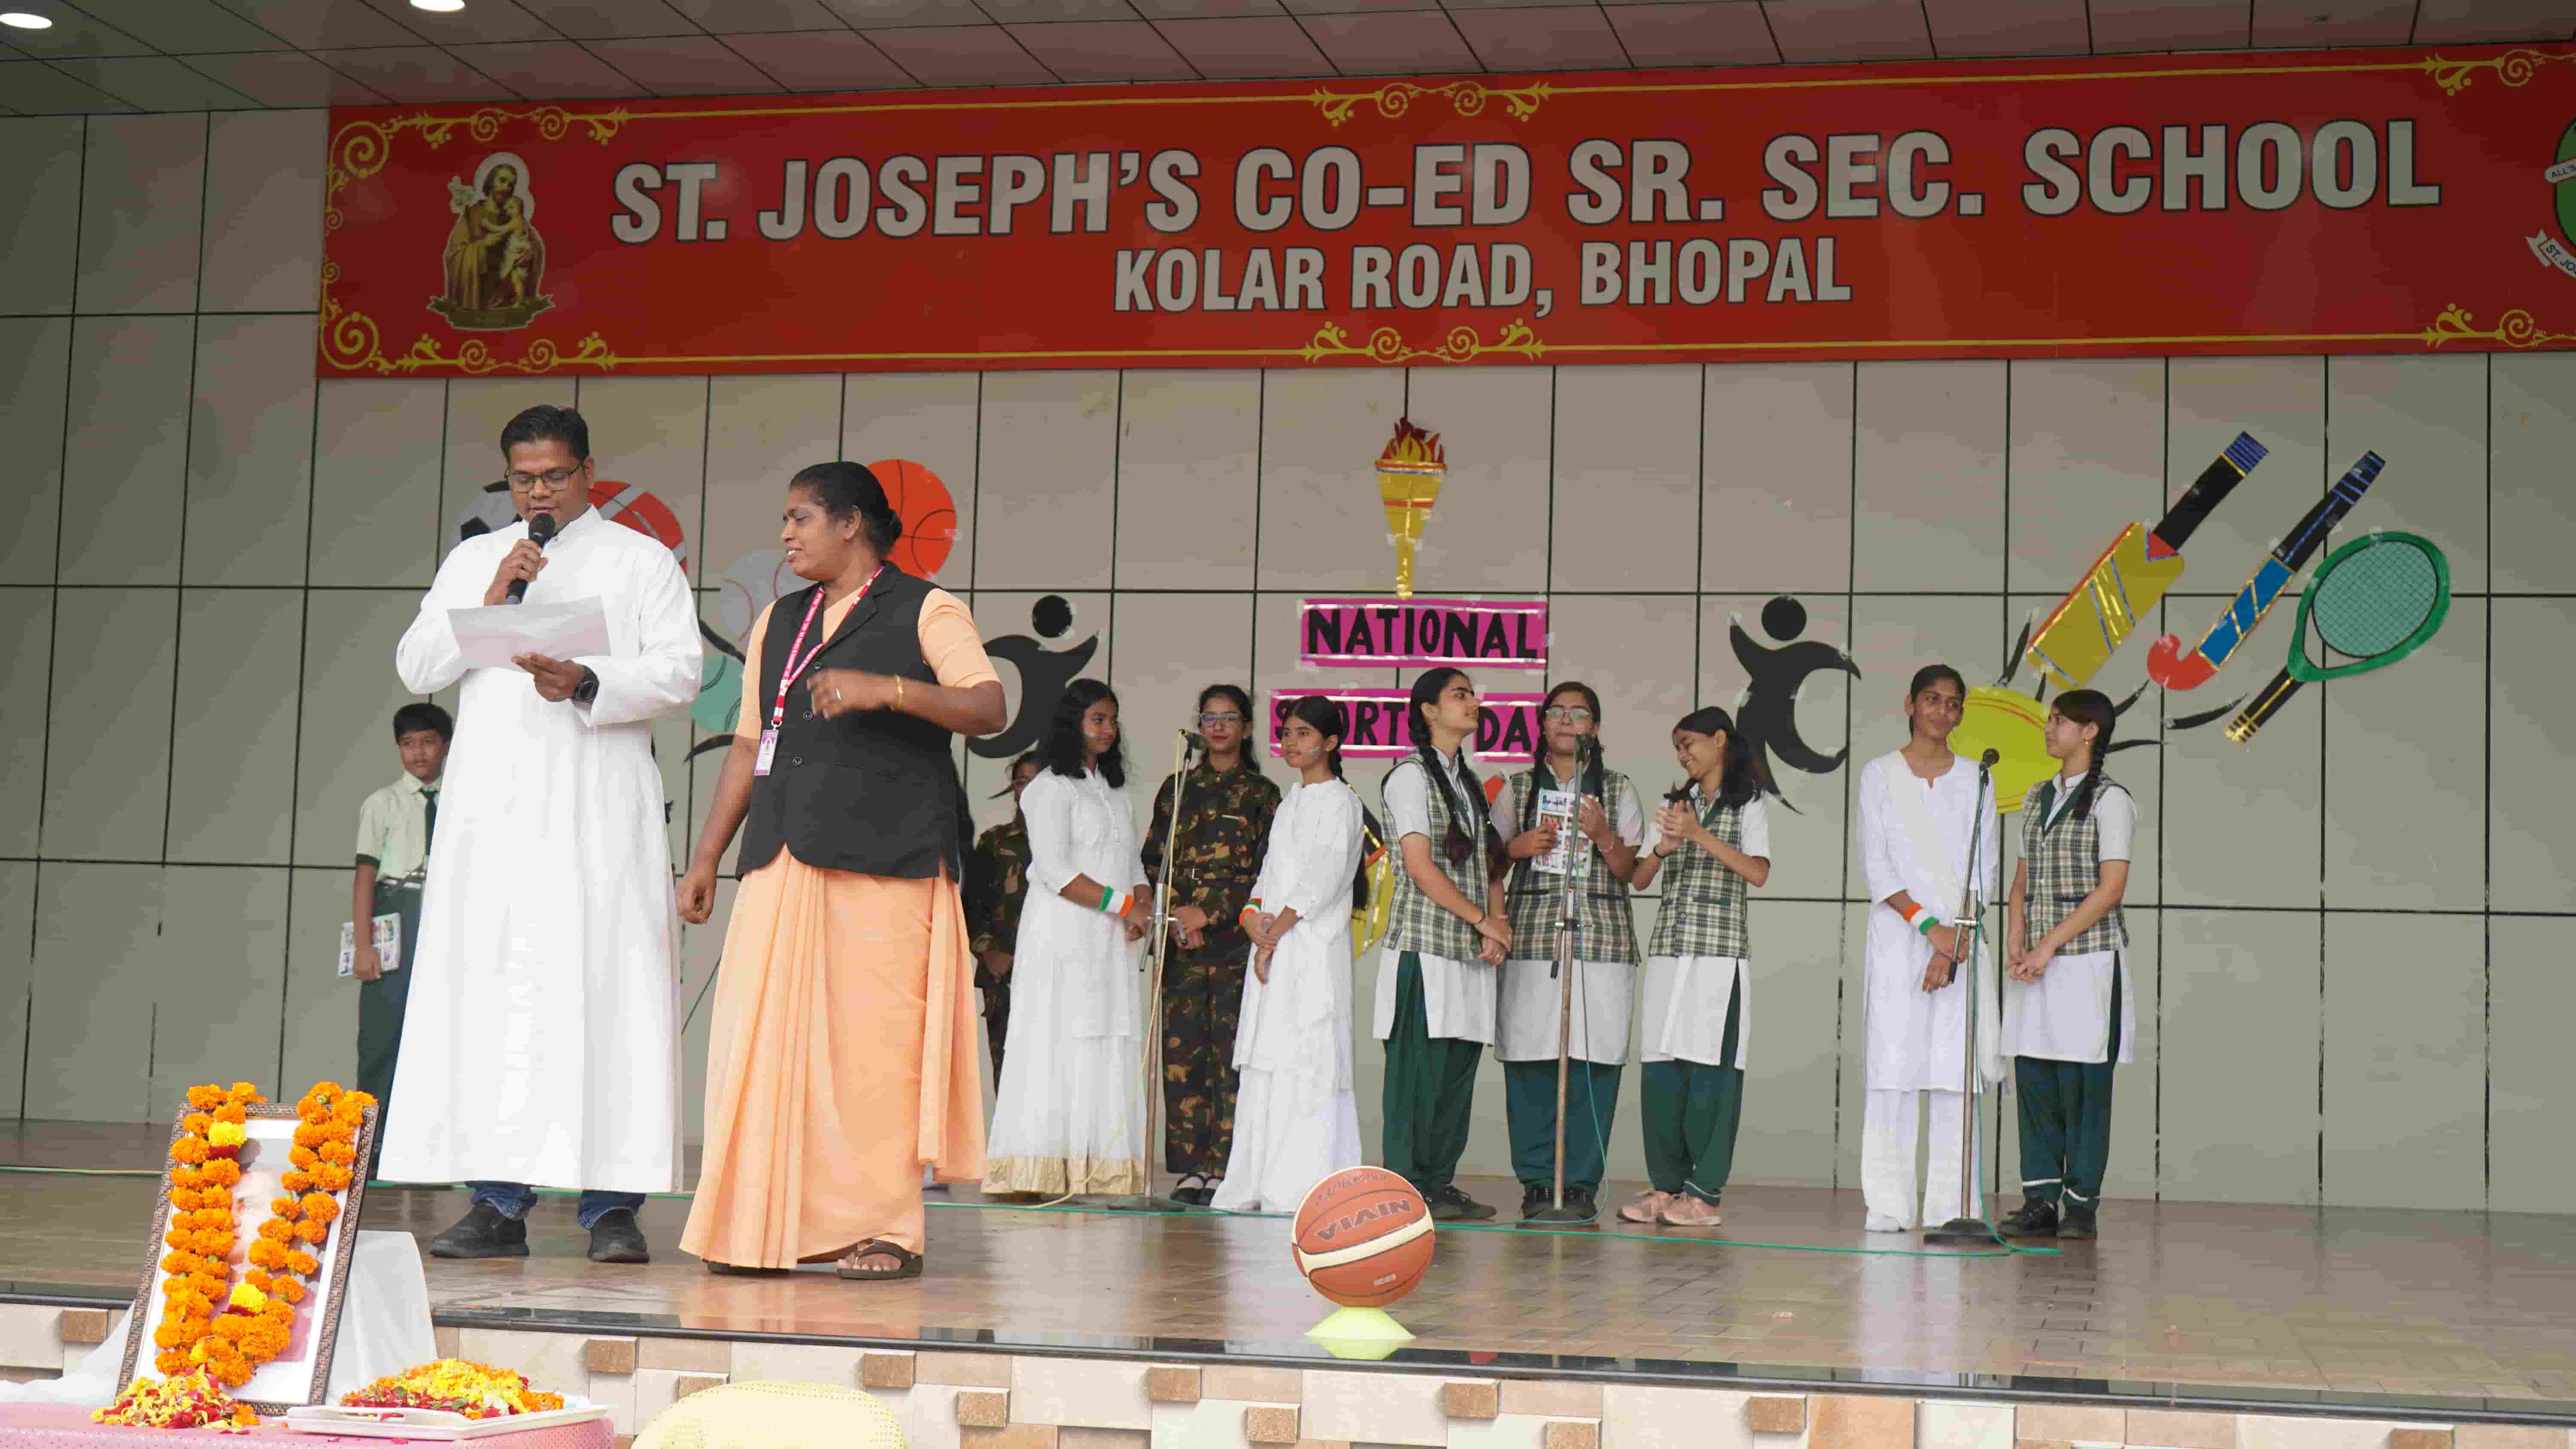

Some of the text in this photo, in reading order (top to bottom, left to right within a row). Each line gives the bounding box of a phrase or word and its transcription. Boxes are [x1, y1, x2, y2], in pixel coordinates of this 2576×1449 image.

[611, 120, 2440, 244] ST. JOSEPH'S CO-ED SR. SEC. SCHOOL
[1114, 236, 1852, 318] KOLAR ROAD, BHOPAL
[1307, 607, 1538, 659] NATIONAL
[1476, 705, 1542, 752] DA
[1315, 1198, 1413, 1240] NIVIA
